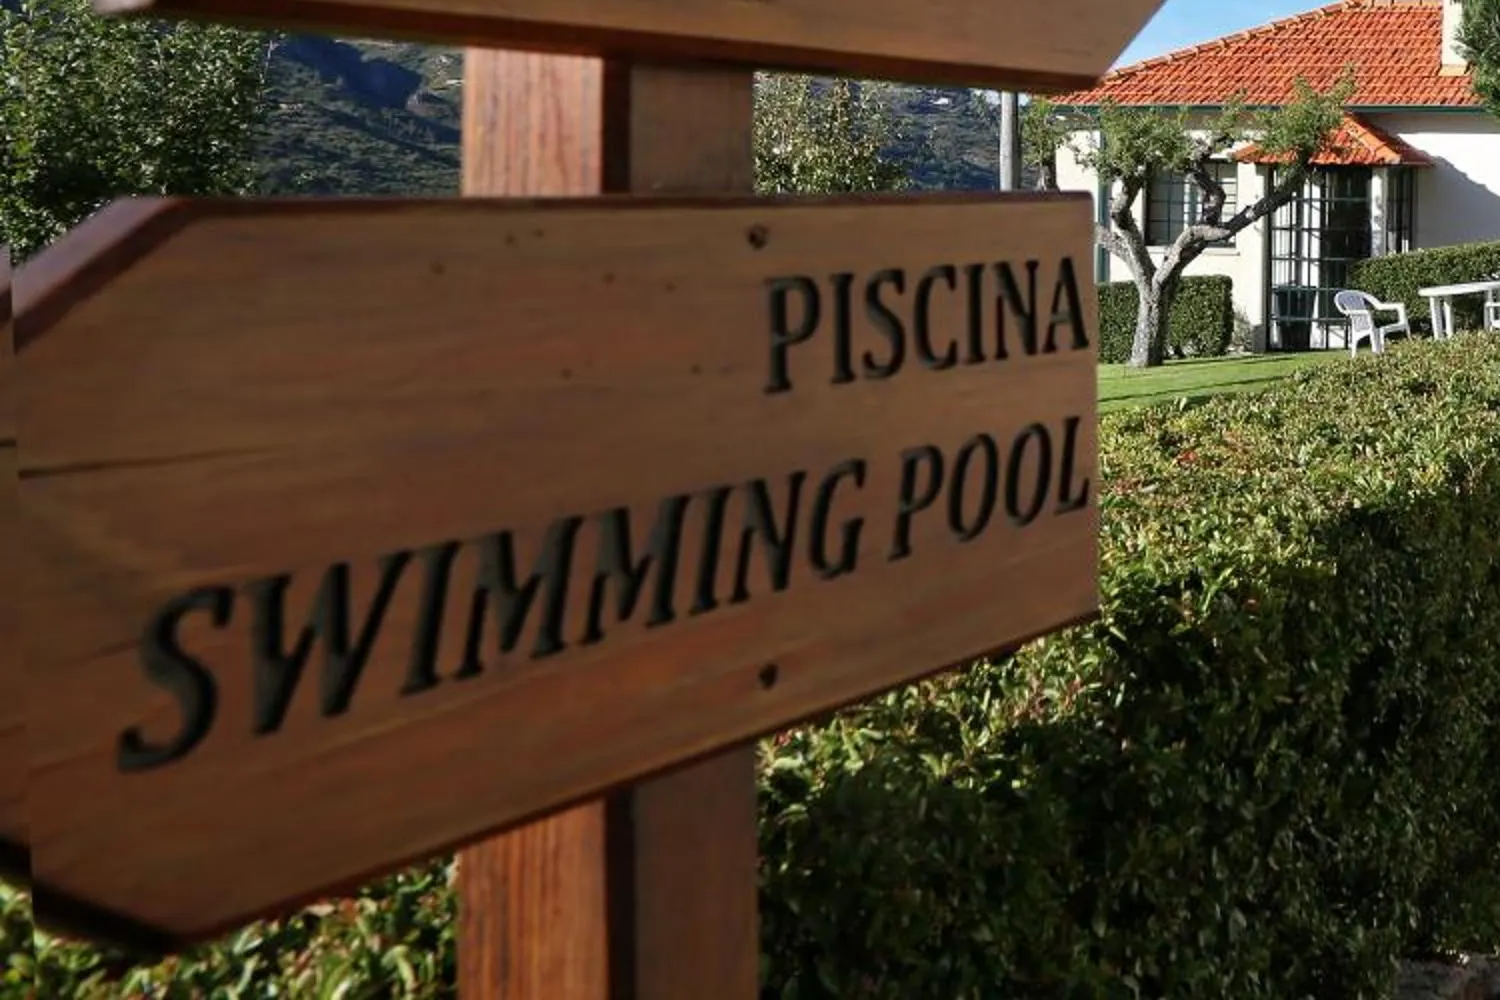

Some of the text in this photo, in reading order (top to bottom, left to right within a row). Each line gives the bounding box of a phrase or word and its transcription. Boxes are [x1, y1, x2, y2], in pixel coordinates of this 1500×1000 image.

[764, 255, 1090, 396] PISCINA
[114, 414, 1092, 773] SWIMMING POOL
